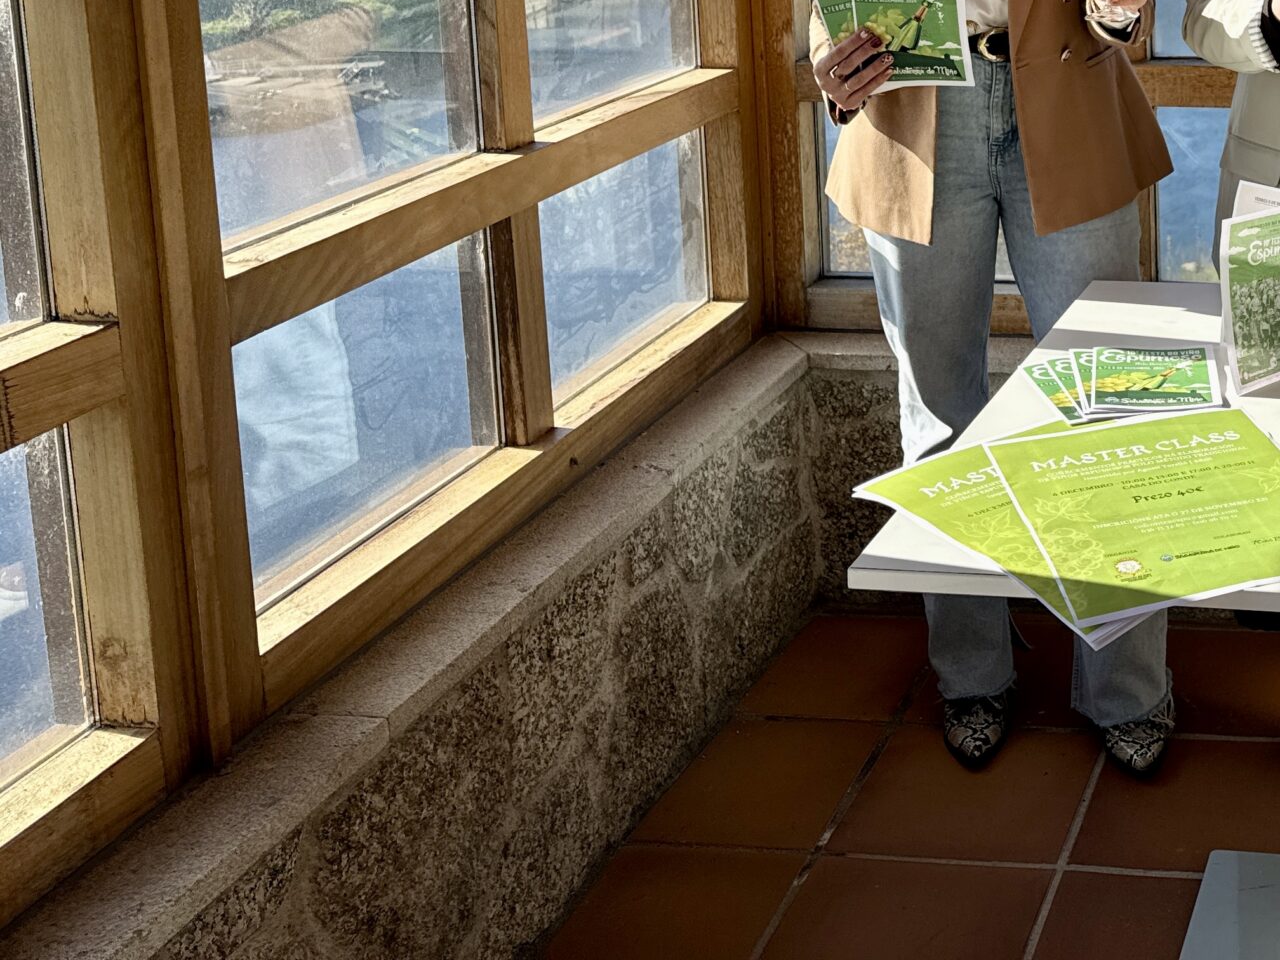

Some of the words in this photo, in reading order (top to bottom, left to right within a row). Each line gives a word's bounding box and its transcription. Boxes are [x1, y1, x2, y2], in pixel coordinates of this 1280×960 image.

[1100, 349, 1202, 363] Espumoso
[1030, 445, 1153, 473] MASTER
[1155, 430, 1241, 451] CLASS
[919, 466, 1001, 498] MAST
[1131, 492, 1172, 504] Prezo
[1177, 486, 1205, 497] 40€
